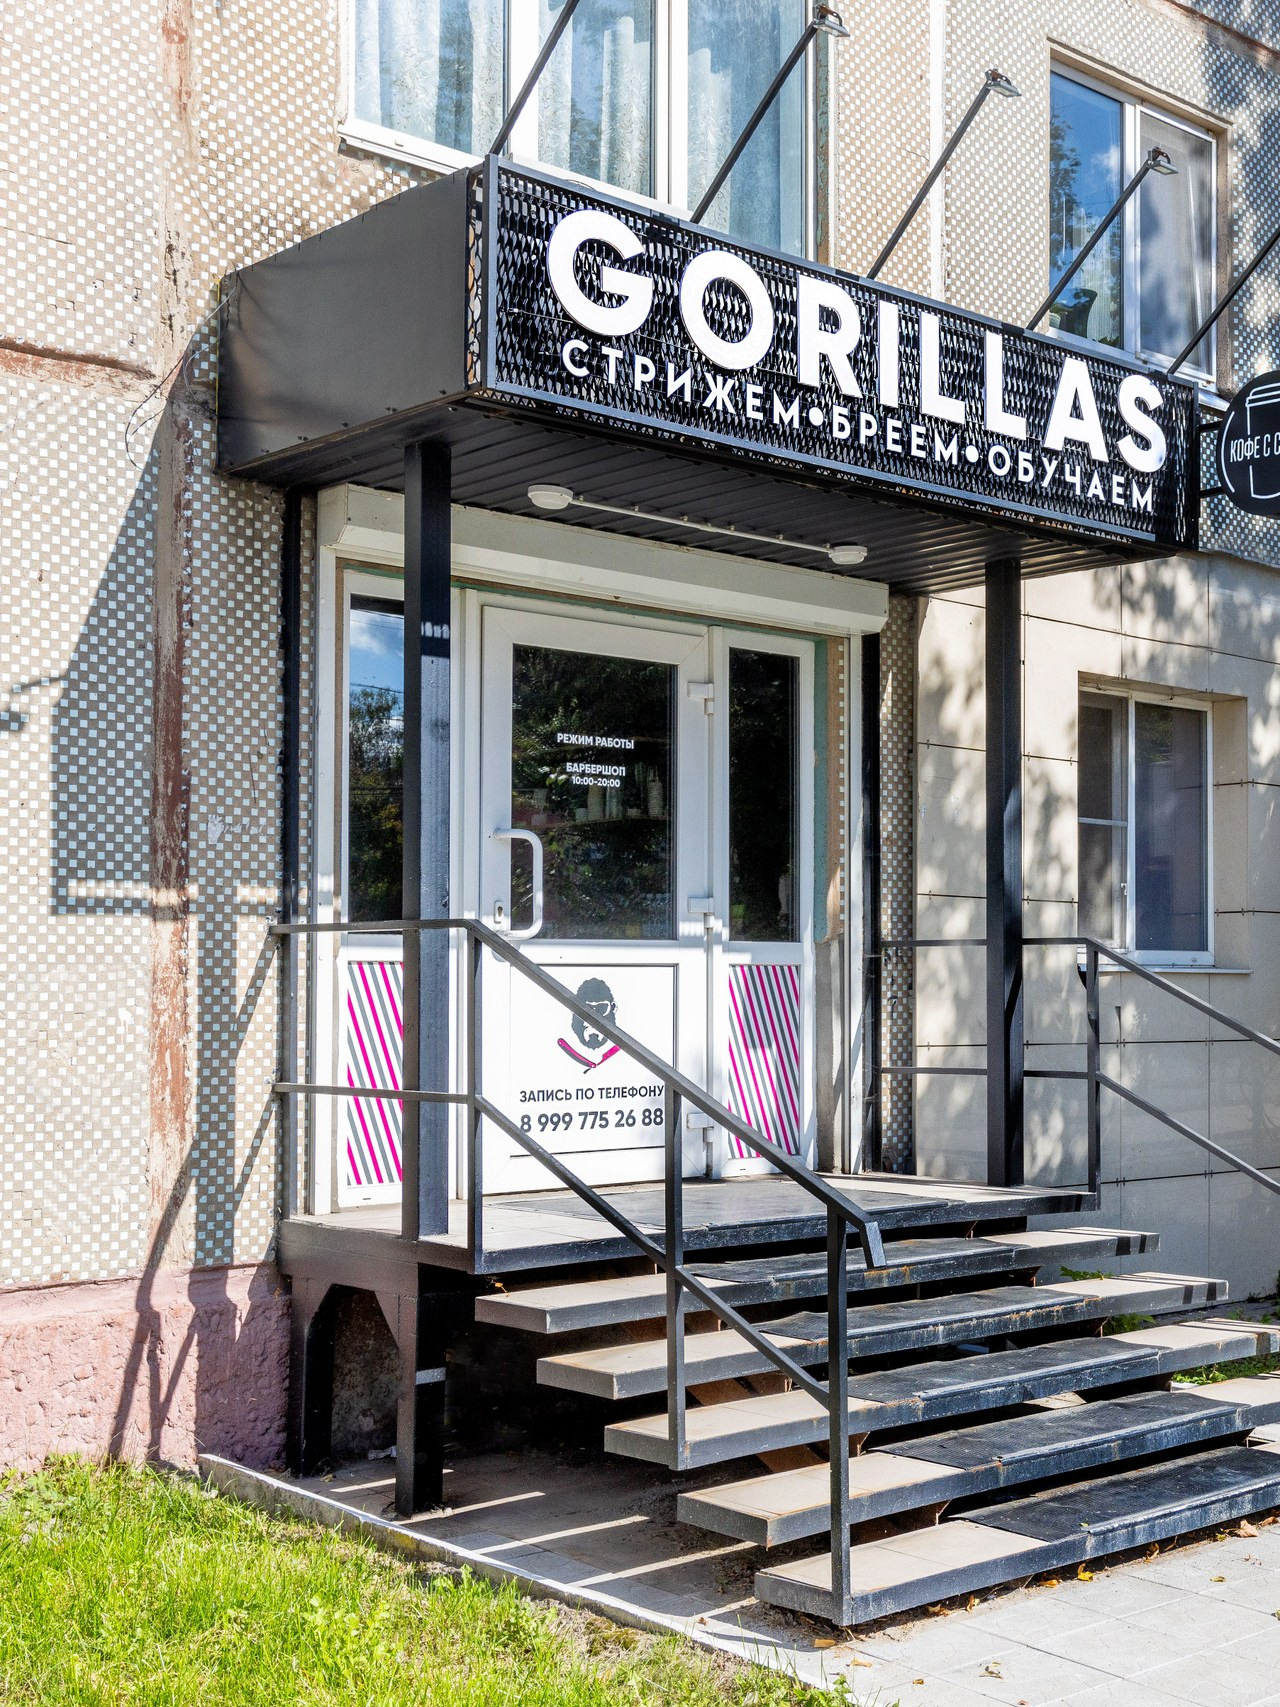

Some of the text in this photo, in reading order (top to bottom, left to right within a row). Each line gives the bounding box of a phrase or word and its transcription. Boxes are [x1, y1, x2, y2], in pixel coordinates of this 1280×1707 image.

[546, 209, 1167, 473] GORILLAS
[562, 339, 1153, 512] СТРИЖЕМ БРЕЕМ ОБУЧАЕМ
[1230, 435, 1261, 463] КОФЕ
[1263, 433, 1271, 457] С
[557, 733, 635, 749] РЕЖИМ РАБОТЫ
[566, 762, 626, 776] БАРБЕРШОП
[571, 775, 621, 788] 10:00-20:00
[519, 1085, 665, 1103] ЗАПИСЬ ПО ТЕЛЕФОНУ
[520, 1107, 664, 1133] 8 999 775 26 88
